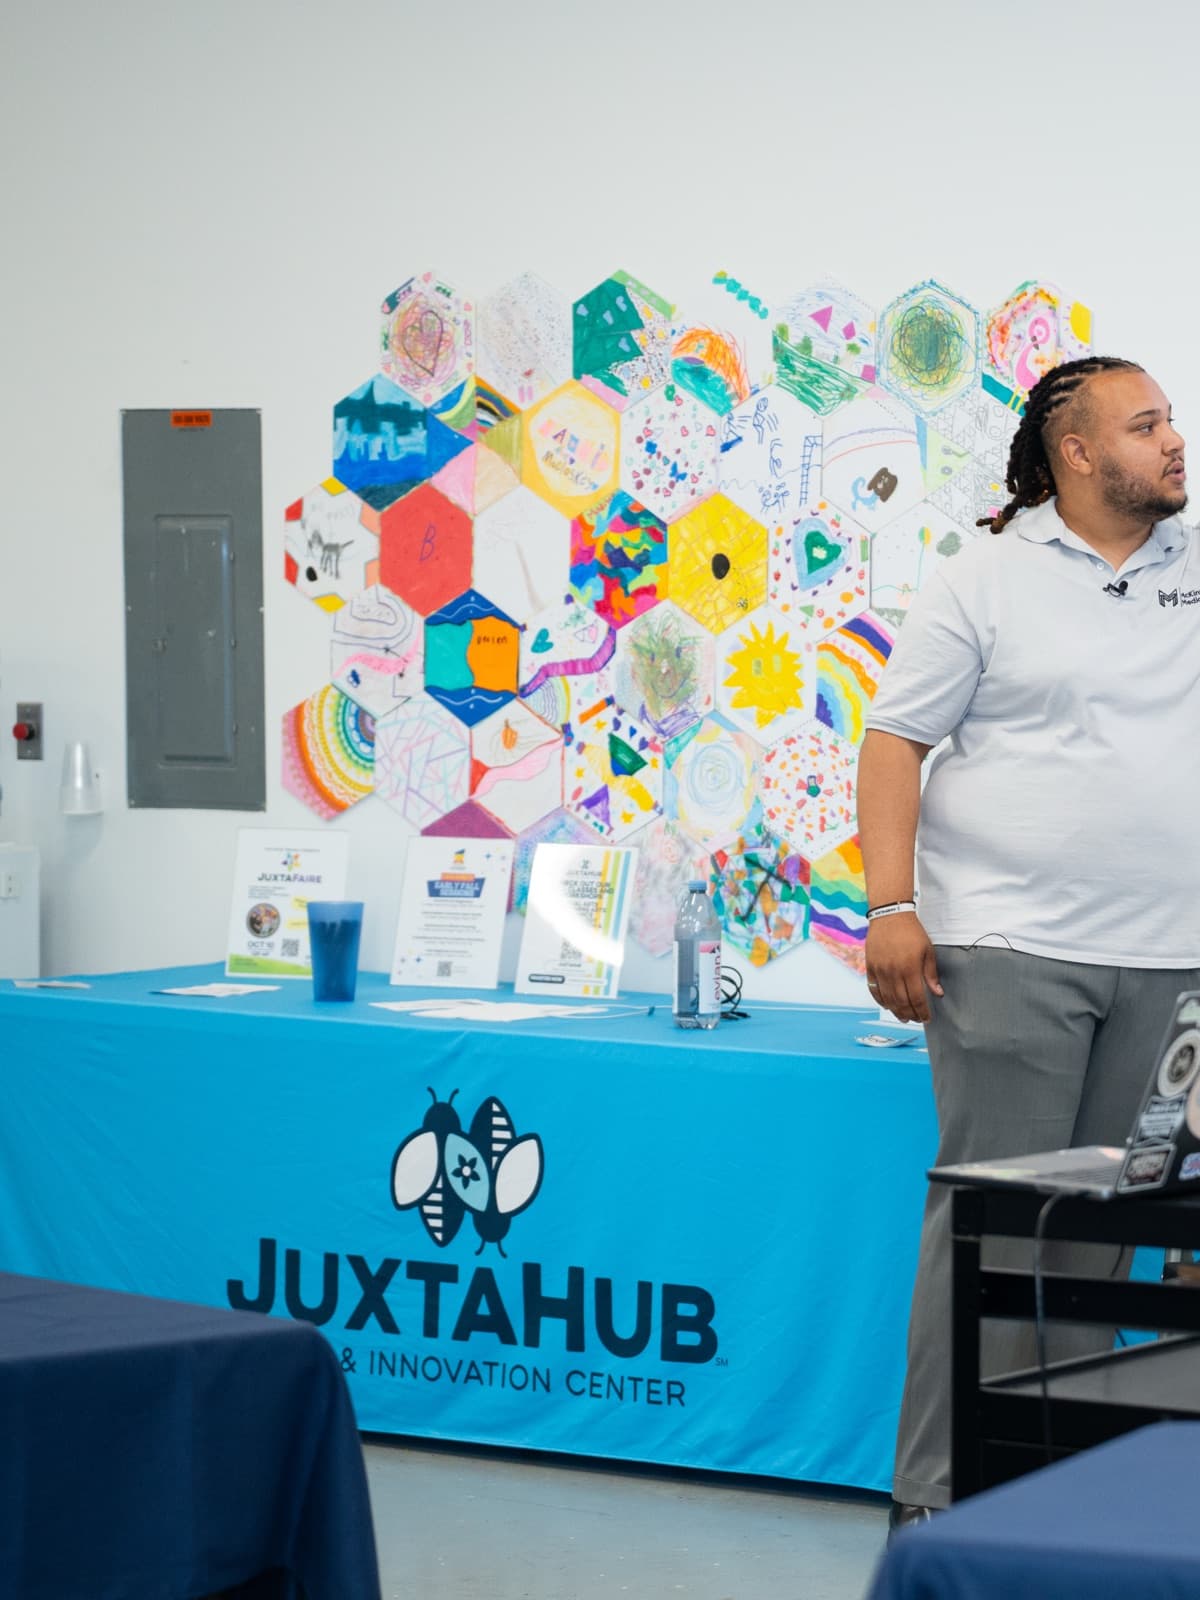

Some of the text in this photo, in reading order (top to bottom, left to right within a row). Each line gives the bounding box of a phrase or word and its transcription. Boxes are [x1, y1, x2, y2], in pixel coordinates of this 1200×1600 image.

[419, 524, 437, 562] B
[257, 872, 322, 884] JUXTAFAIRE
[226, 1236, 719, 1365] JUXTAHUB
[340, 1347, 686, 1407] & INNOVATION CENTER
